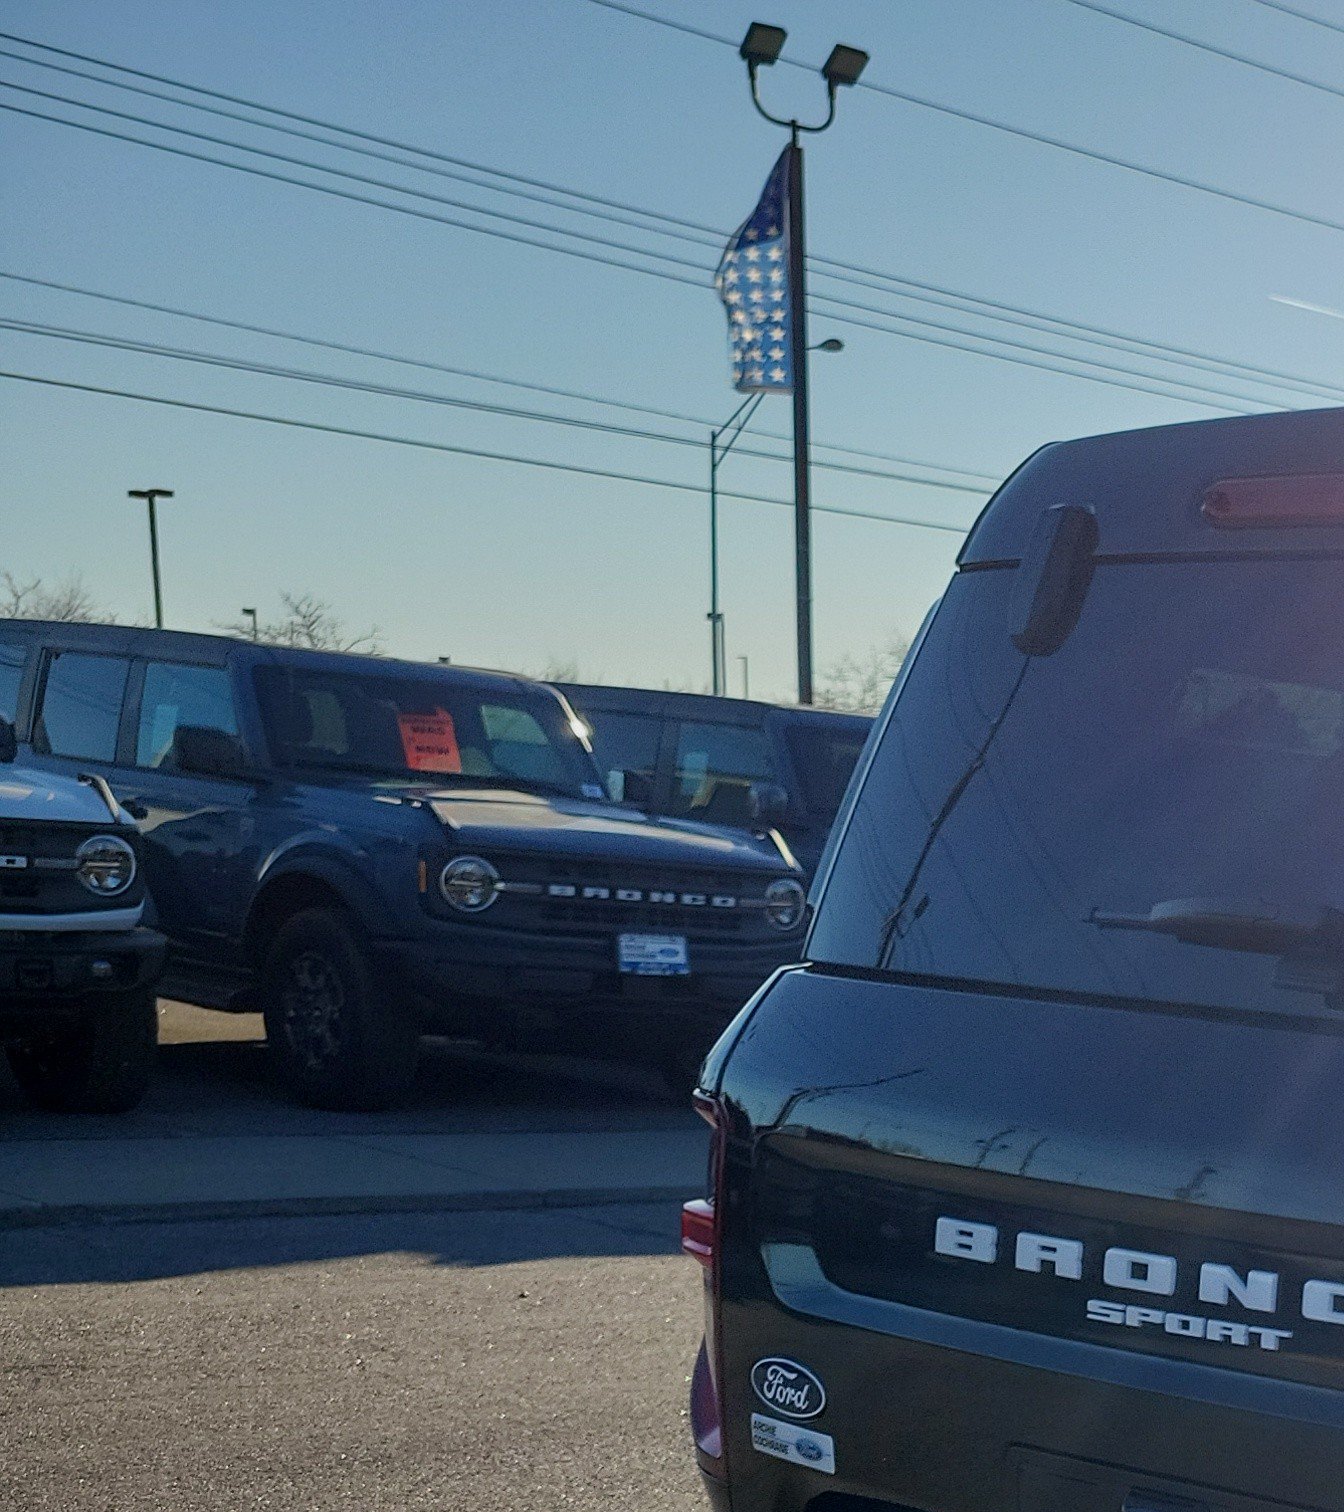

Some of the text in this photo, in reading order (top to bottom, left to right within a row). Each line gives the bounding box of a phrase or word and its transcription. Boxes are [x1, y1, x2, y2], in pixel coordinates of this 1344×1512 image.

[548, 885, 736, 908] BRONCO
[1085, 1299, 1293, 1351] SPORT
[763, 1364, 811, 1411] Ford
